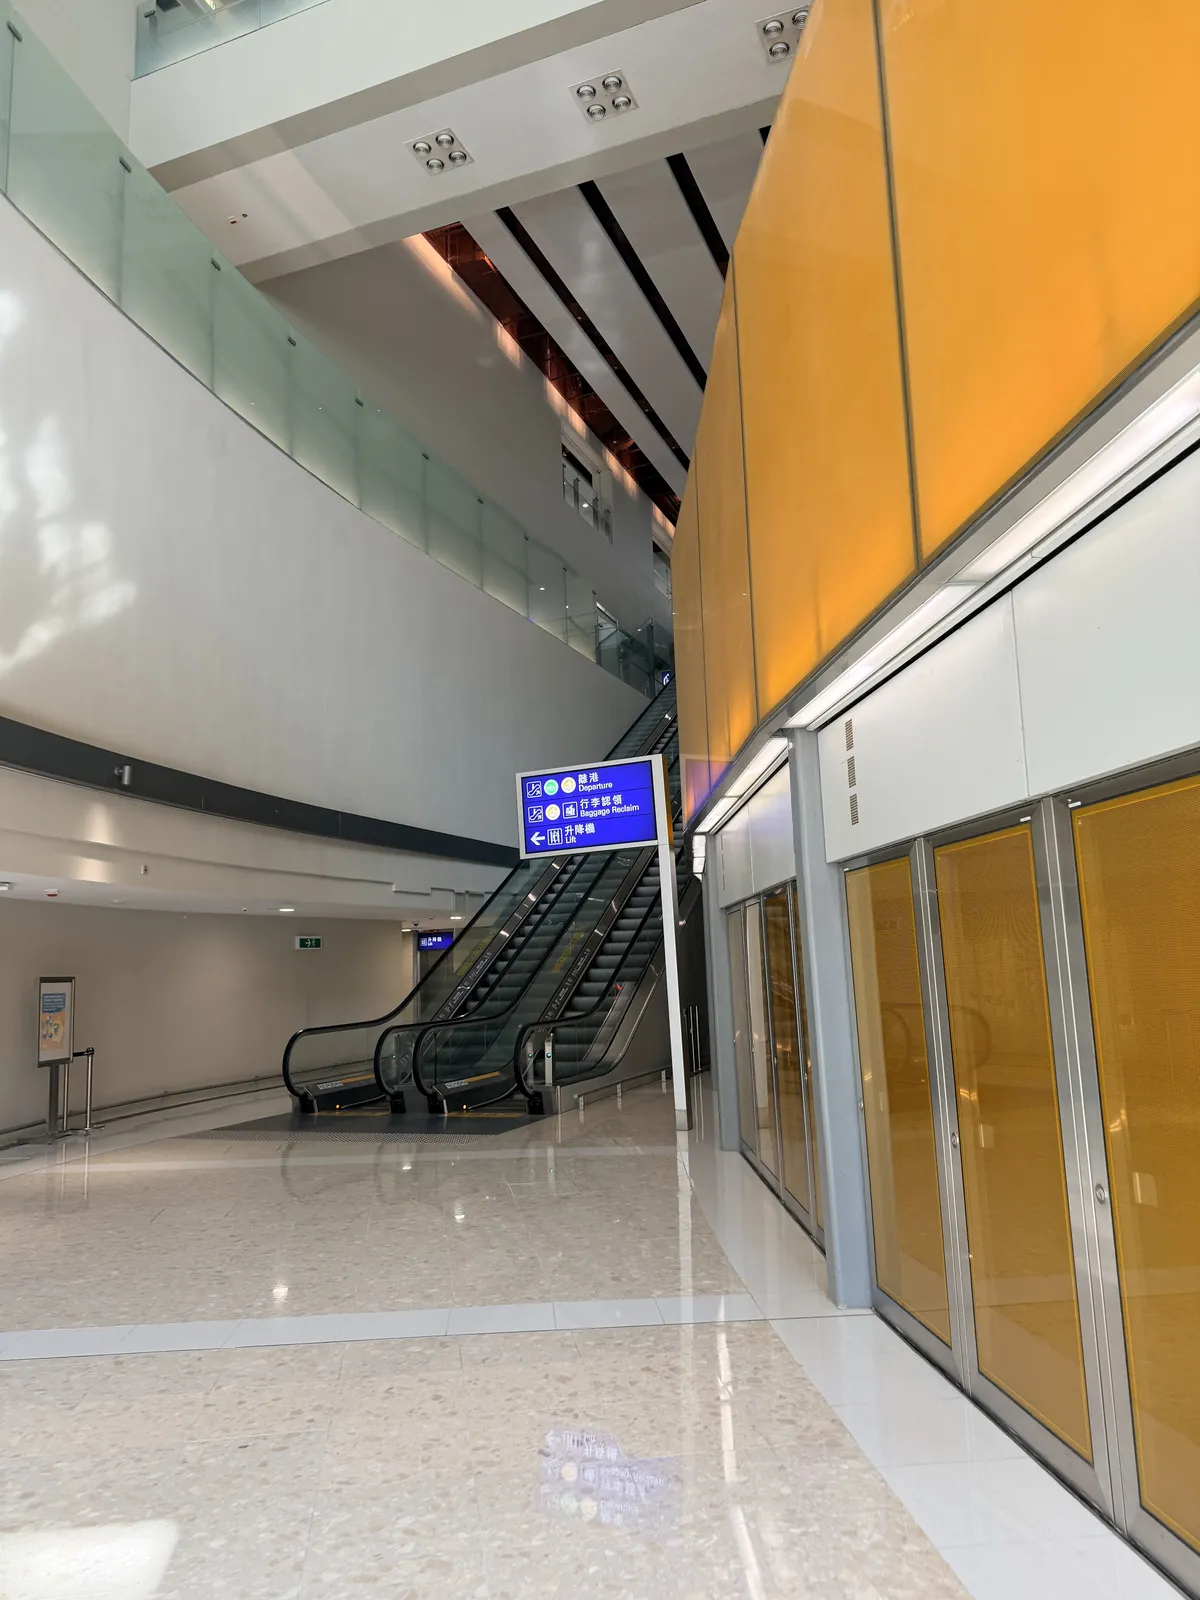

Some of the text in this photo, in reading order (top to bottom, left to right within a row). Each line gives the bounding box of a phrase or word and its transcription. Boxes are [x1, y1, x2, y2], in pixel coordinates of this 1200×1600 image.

[578, 772, 599, 784] 離港
[578, 782, 613, 792] Departure
[580, 795, 622, 809] 行李認領
[581, 805, 640, 817] Baggage Reclaim
[565, 823, 595, 836] 升降機
